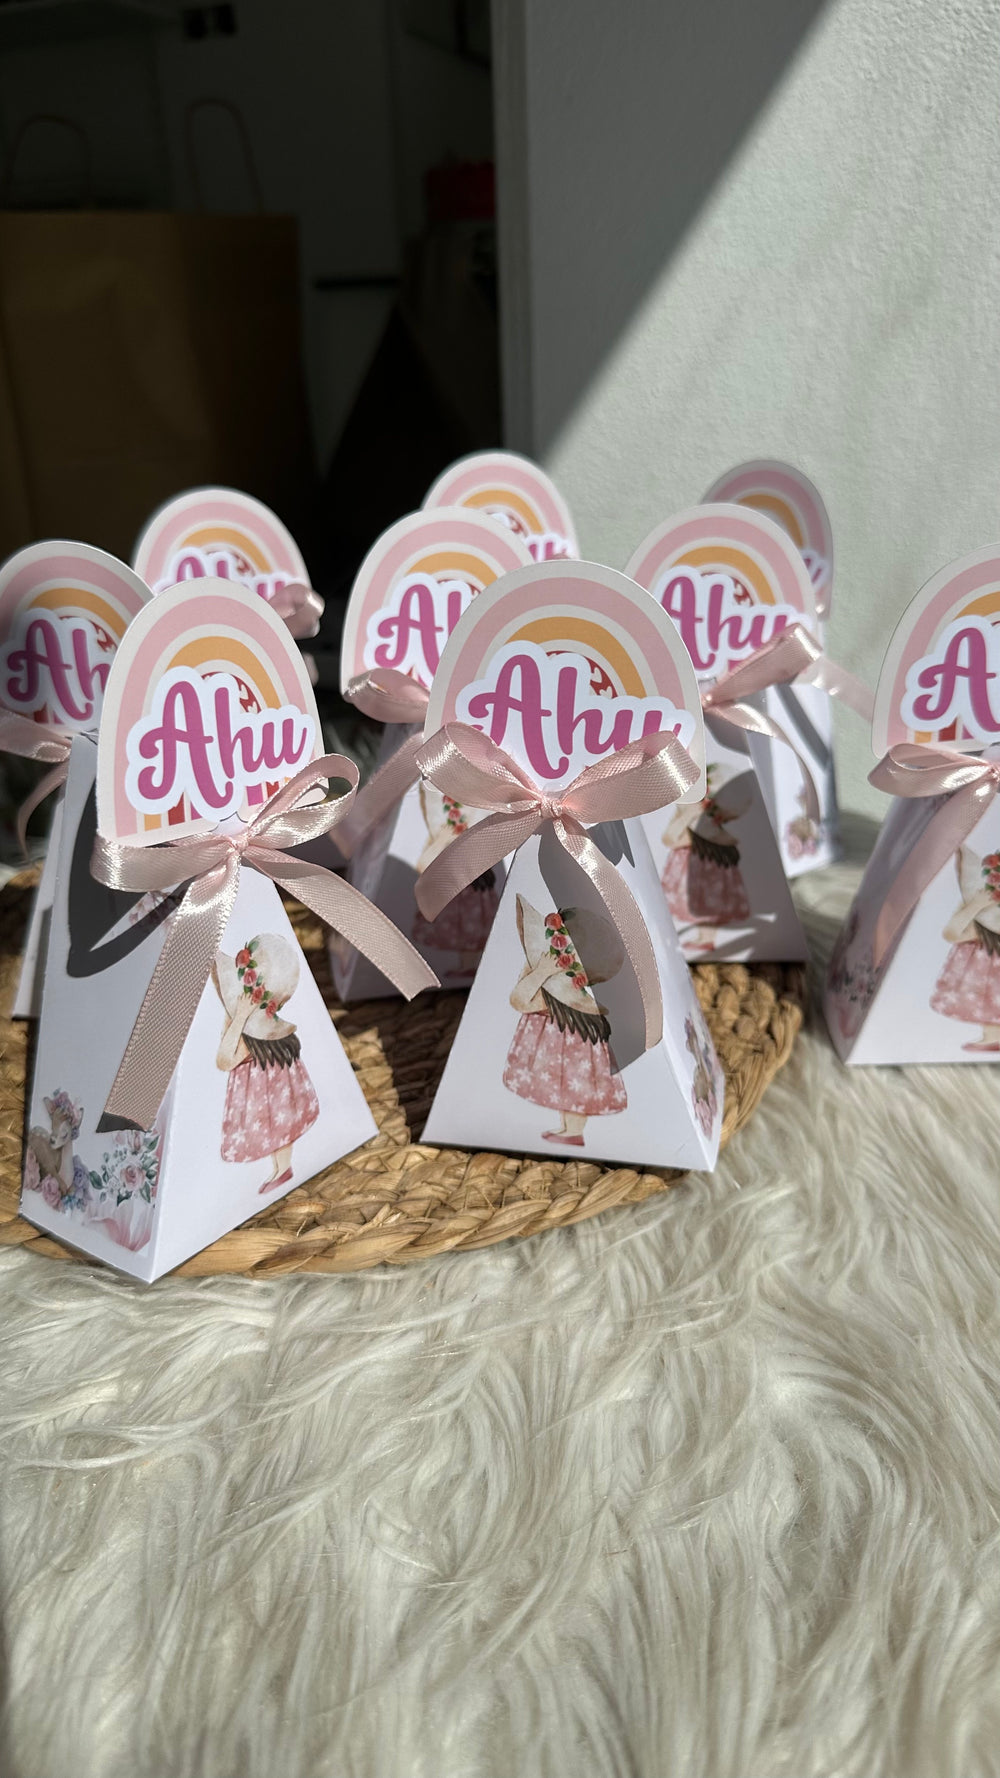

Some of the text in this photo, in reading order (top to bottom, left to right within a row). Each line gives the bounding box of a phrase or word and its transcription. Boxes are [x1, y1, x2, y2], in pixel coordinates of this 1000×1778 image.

[7, 618, 110, 721] Ah
[661, 576, 789, 671] Ahu
[137, 680, 308, 808] Ahu
[468, 654, 682, 780] Ahu
